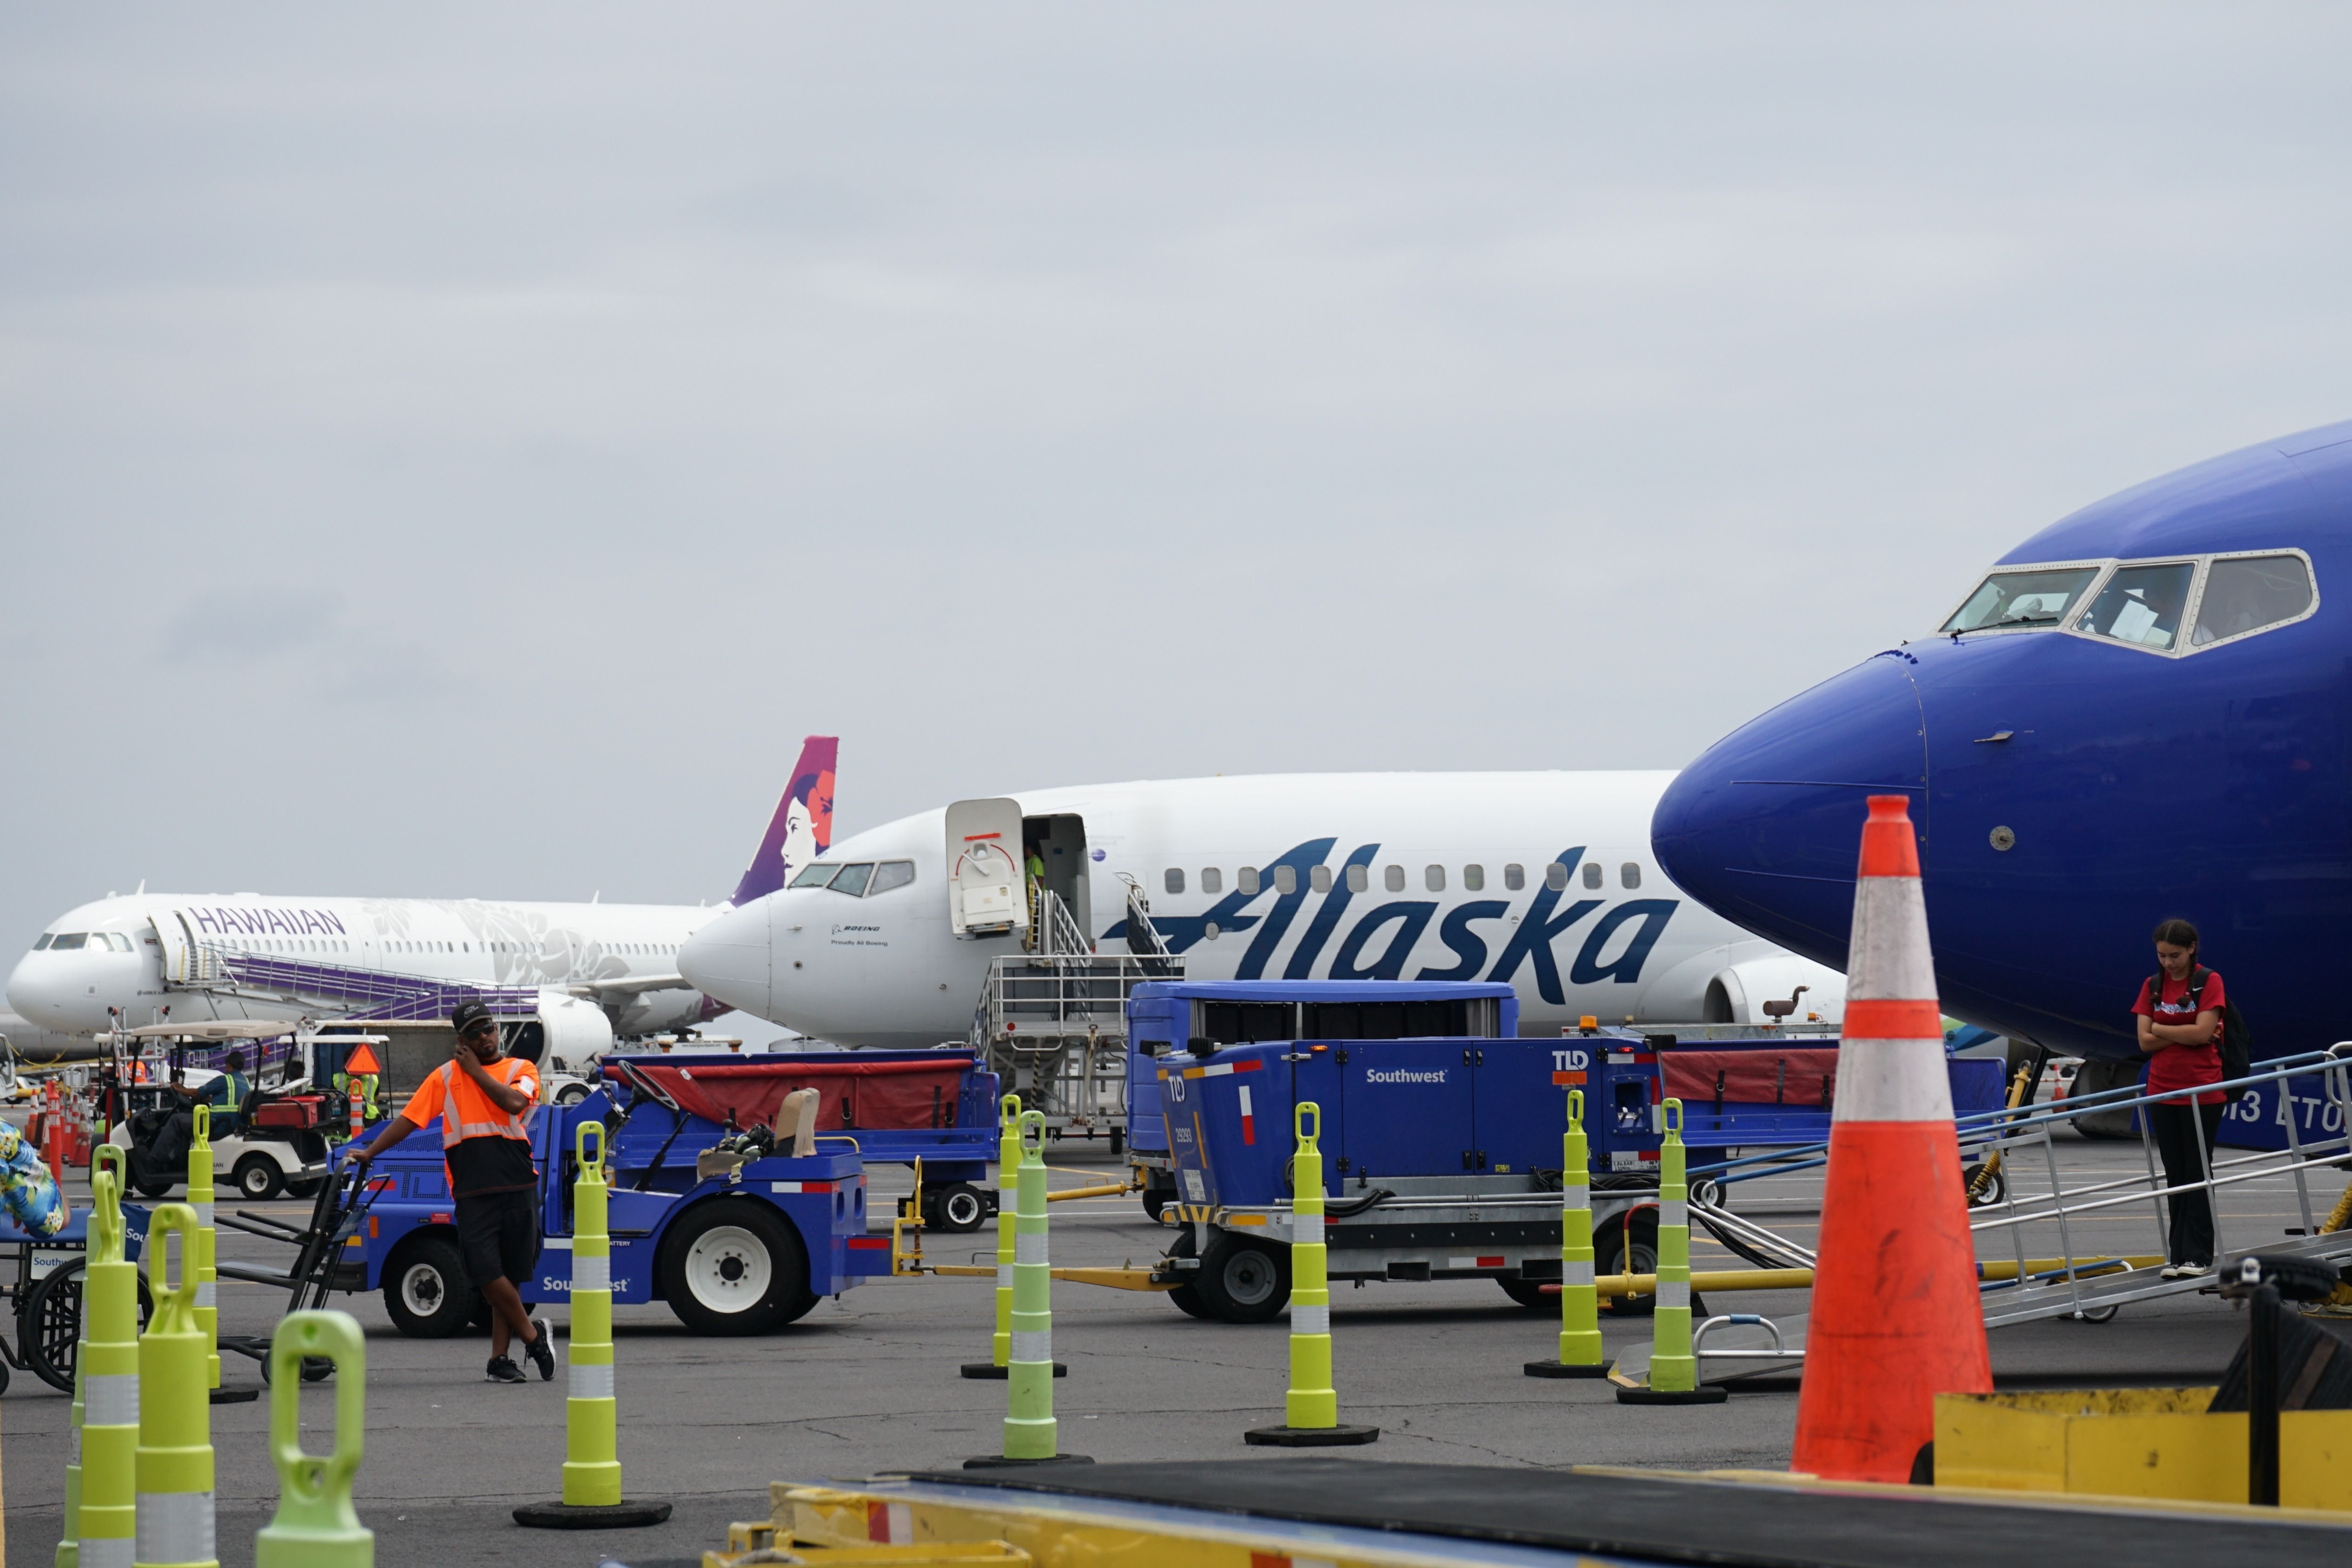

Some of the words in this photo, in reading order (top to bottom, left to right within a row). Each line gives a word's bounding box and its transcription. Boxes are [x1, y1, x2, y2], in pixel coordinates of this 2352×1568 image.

[188, 907, 346, 934] HAWAIIAN
[1100, 837, 1680, 1005] Alaska
[1552, 1050, 1589, 1071] TLD
[1367, 1069, 1445, 1083] Southwest
[1168, 1076, 1185, 1102] TLD
[2222, 1091, 2261, 1122] 13
[2275, 1094, 2347, 1132] ETO
[1176, 1127, 1192, 1143] 29293
[34, 1257, 67, 1266] South
[543, 1277, 627, 1292] Soust
